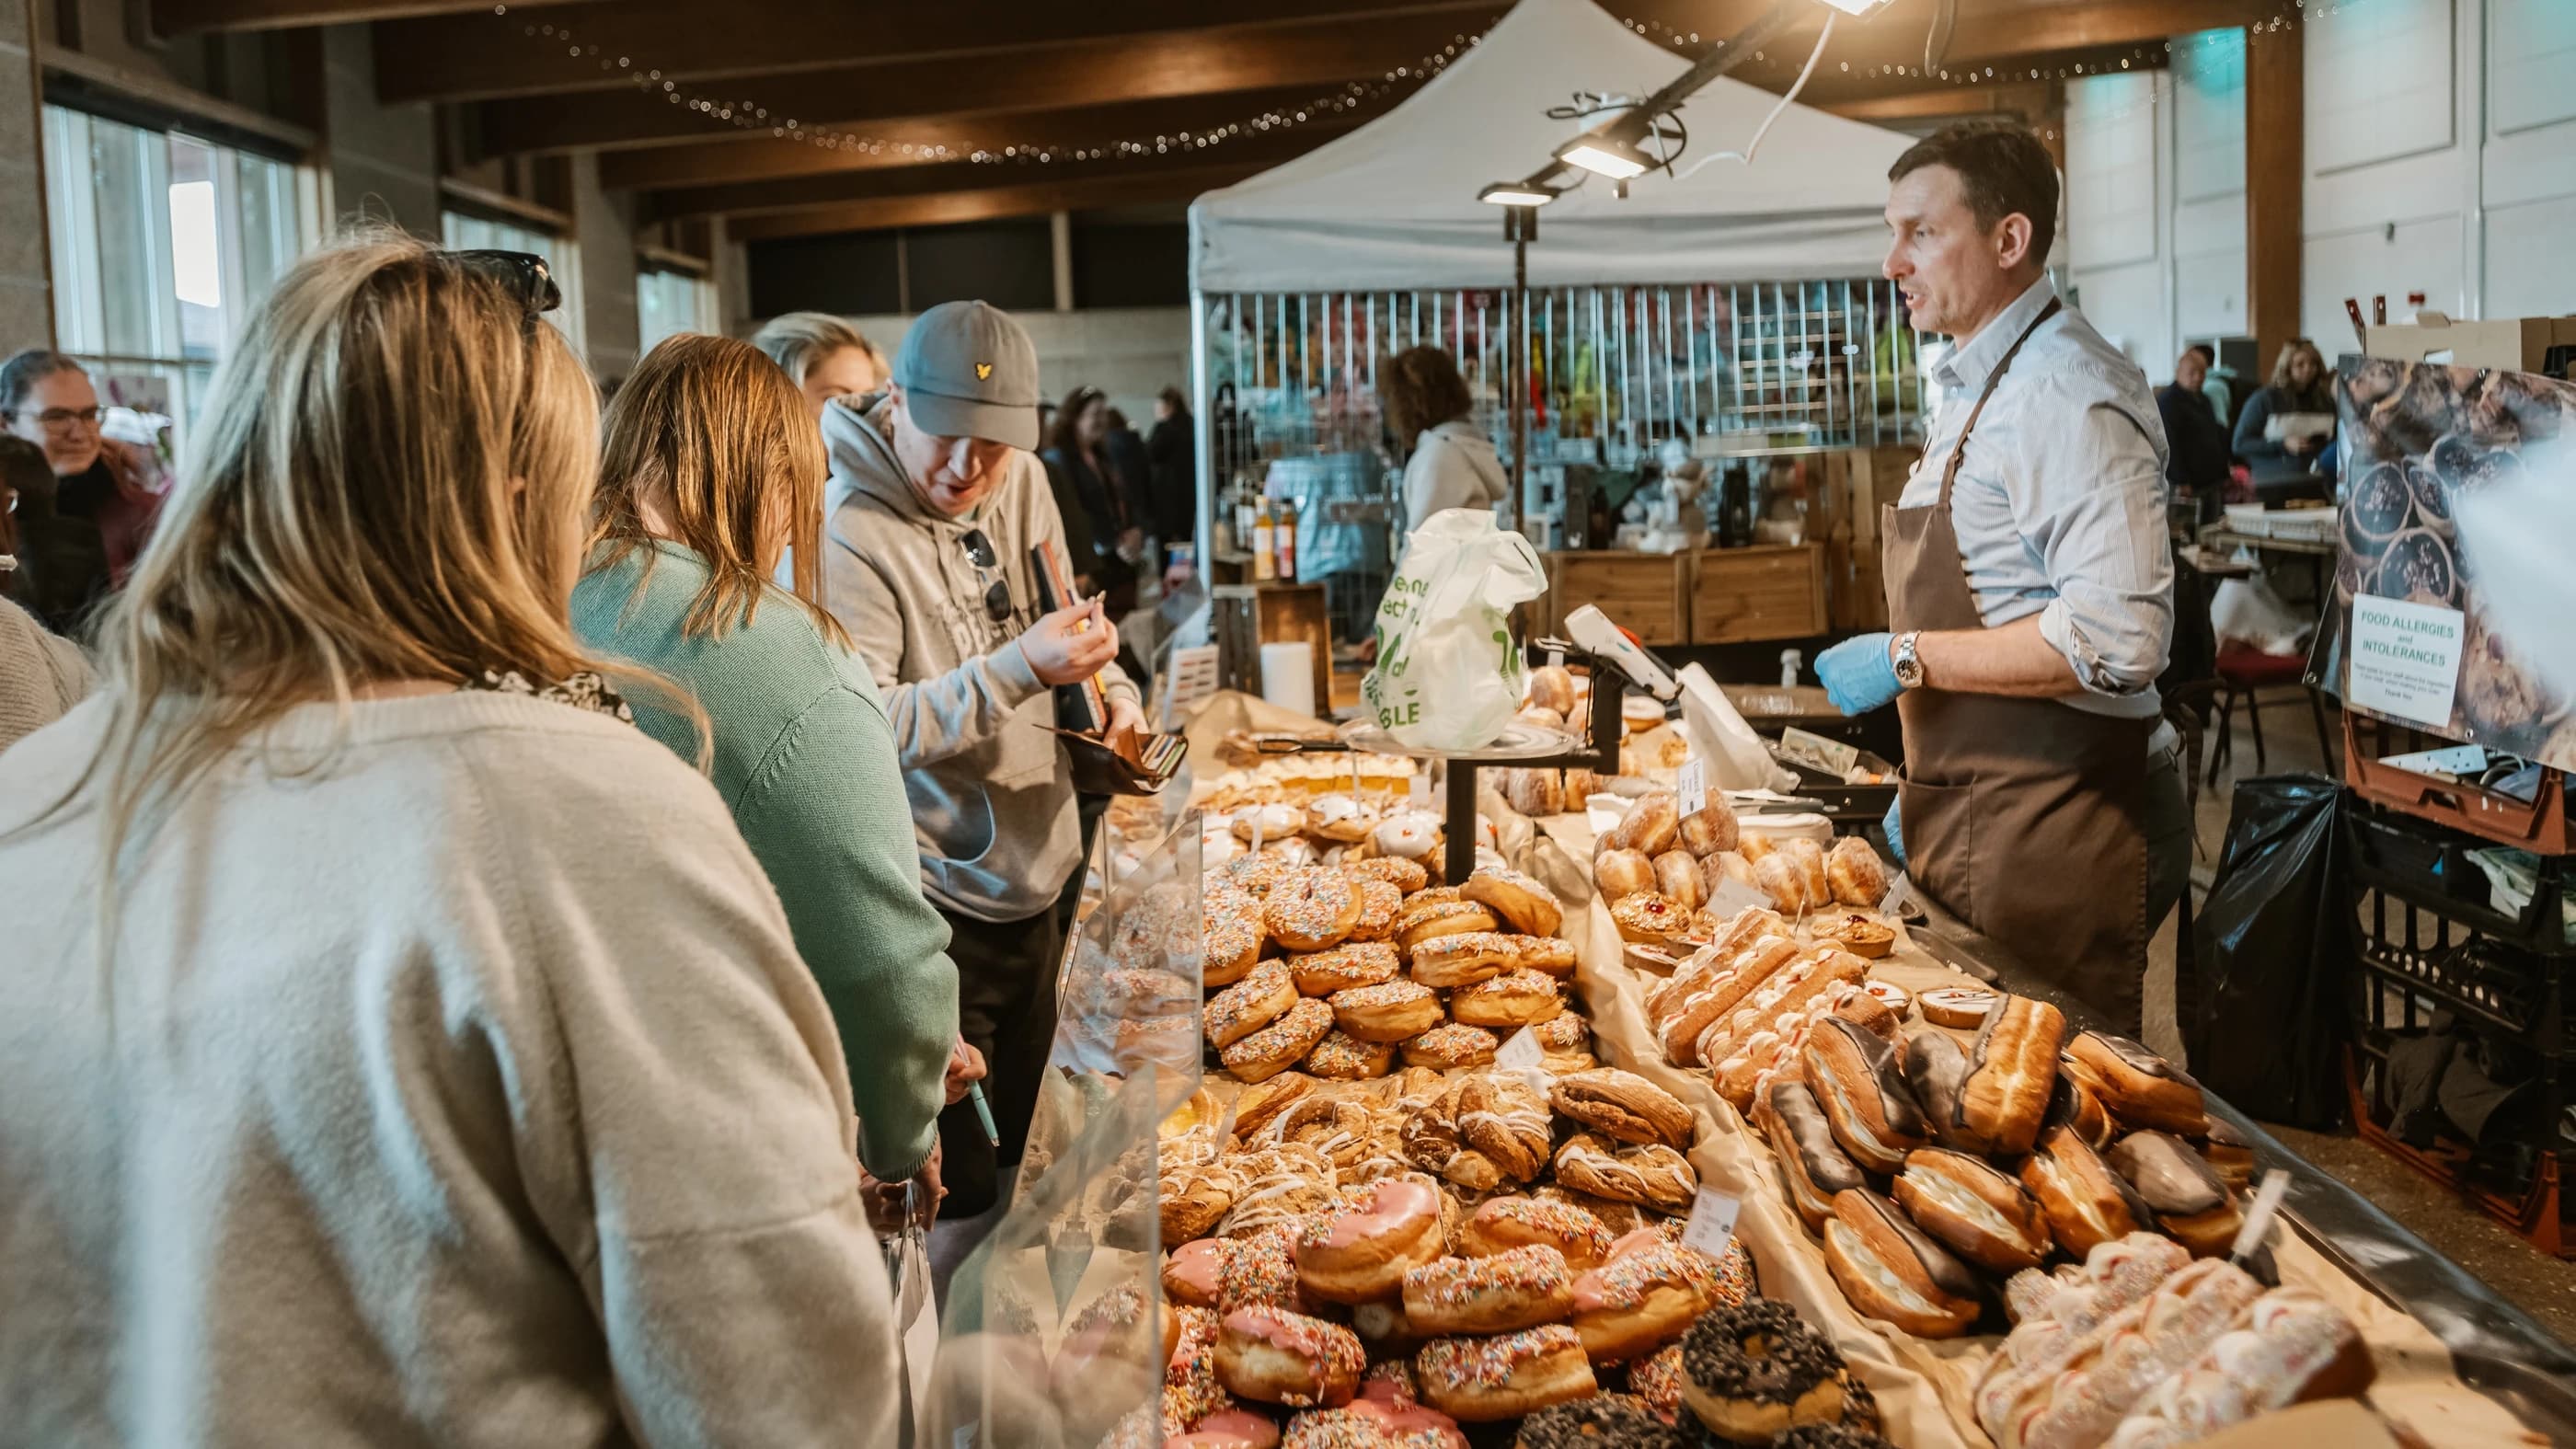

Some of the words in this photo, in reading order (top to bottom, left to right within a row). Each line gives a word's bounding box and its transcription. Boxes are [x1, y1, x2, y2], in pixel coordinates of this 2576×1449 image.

[2362, 611, 2390, 626] FOOD
[2392, 617, 2455, 638] ALLERGIES
[2363, 639, 2446, 667] INTOLERANCES
[2398, 635, 2413, 644] and
